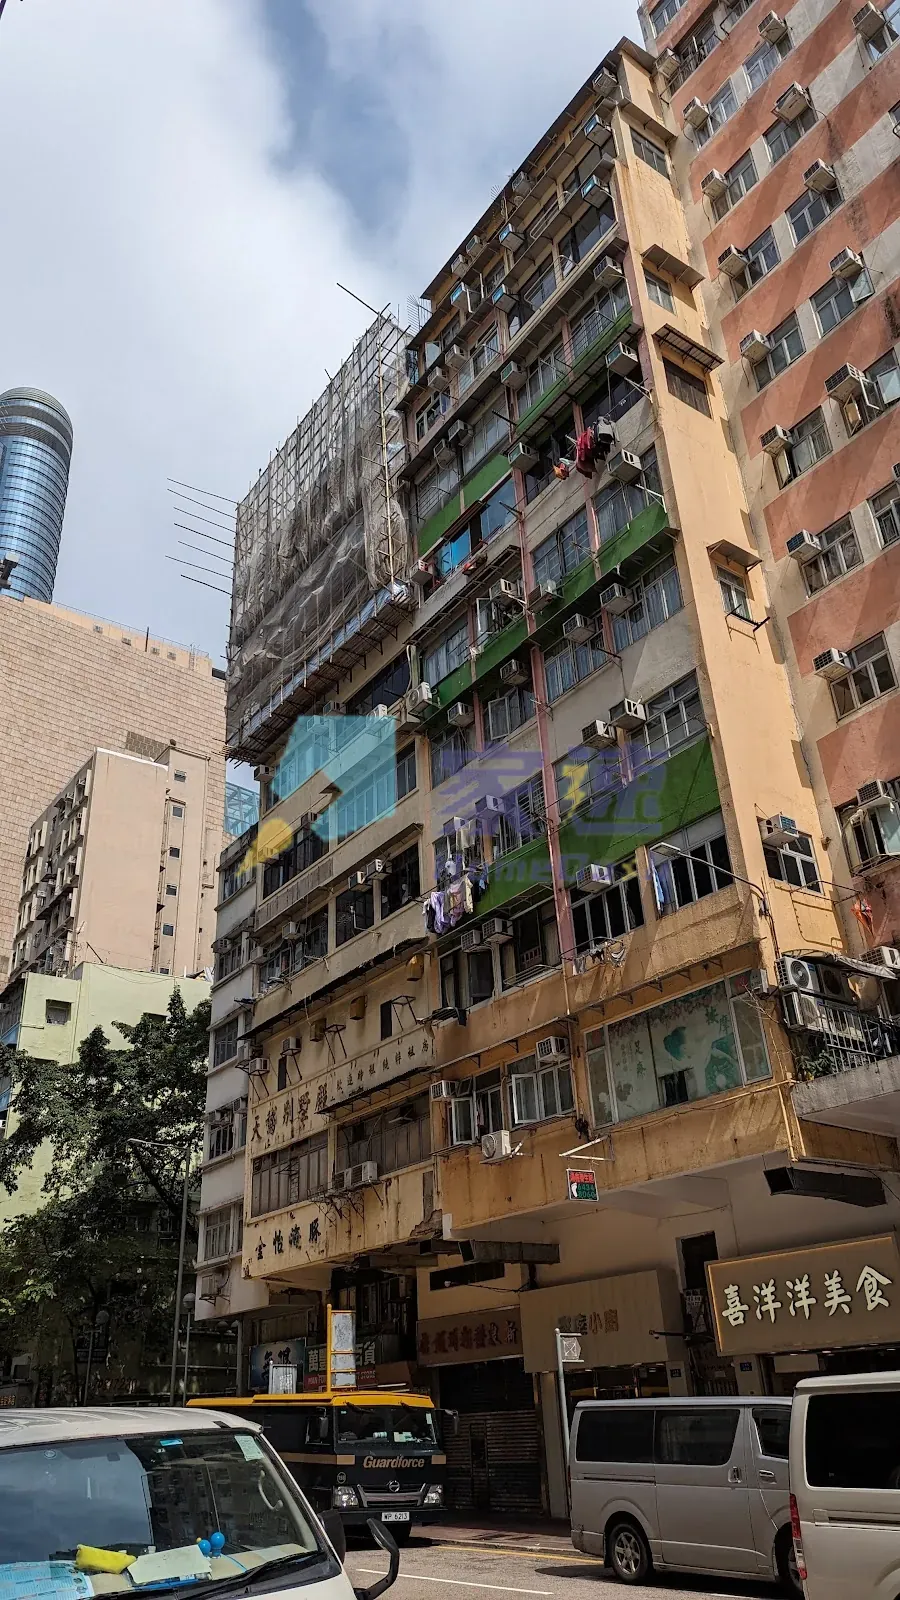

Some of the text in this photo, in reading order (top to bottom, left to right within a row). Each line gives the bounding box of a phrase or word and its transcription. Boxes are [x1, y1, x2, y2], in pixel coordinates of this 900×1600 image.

[722, 1265, 893, 1327] 喜洋洋美食
[363, 1455, 425, 1468] Guardforce
